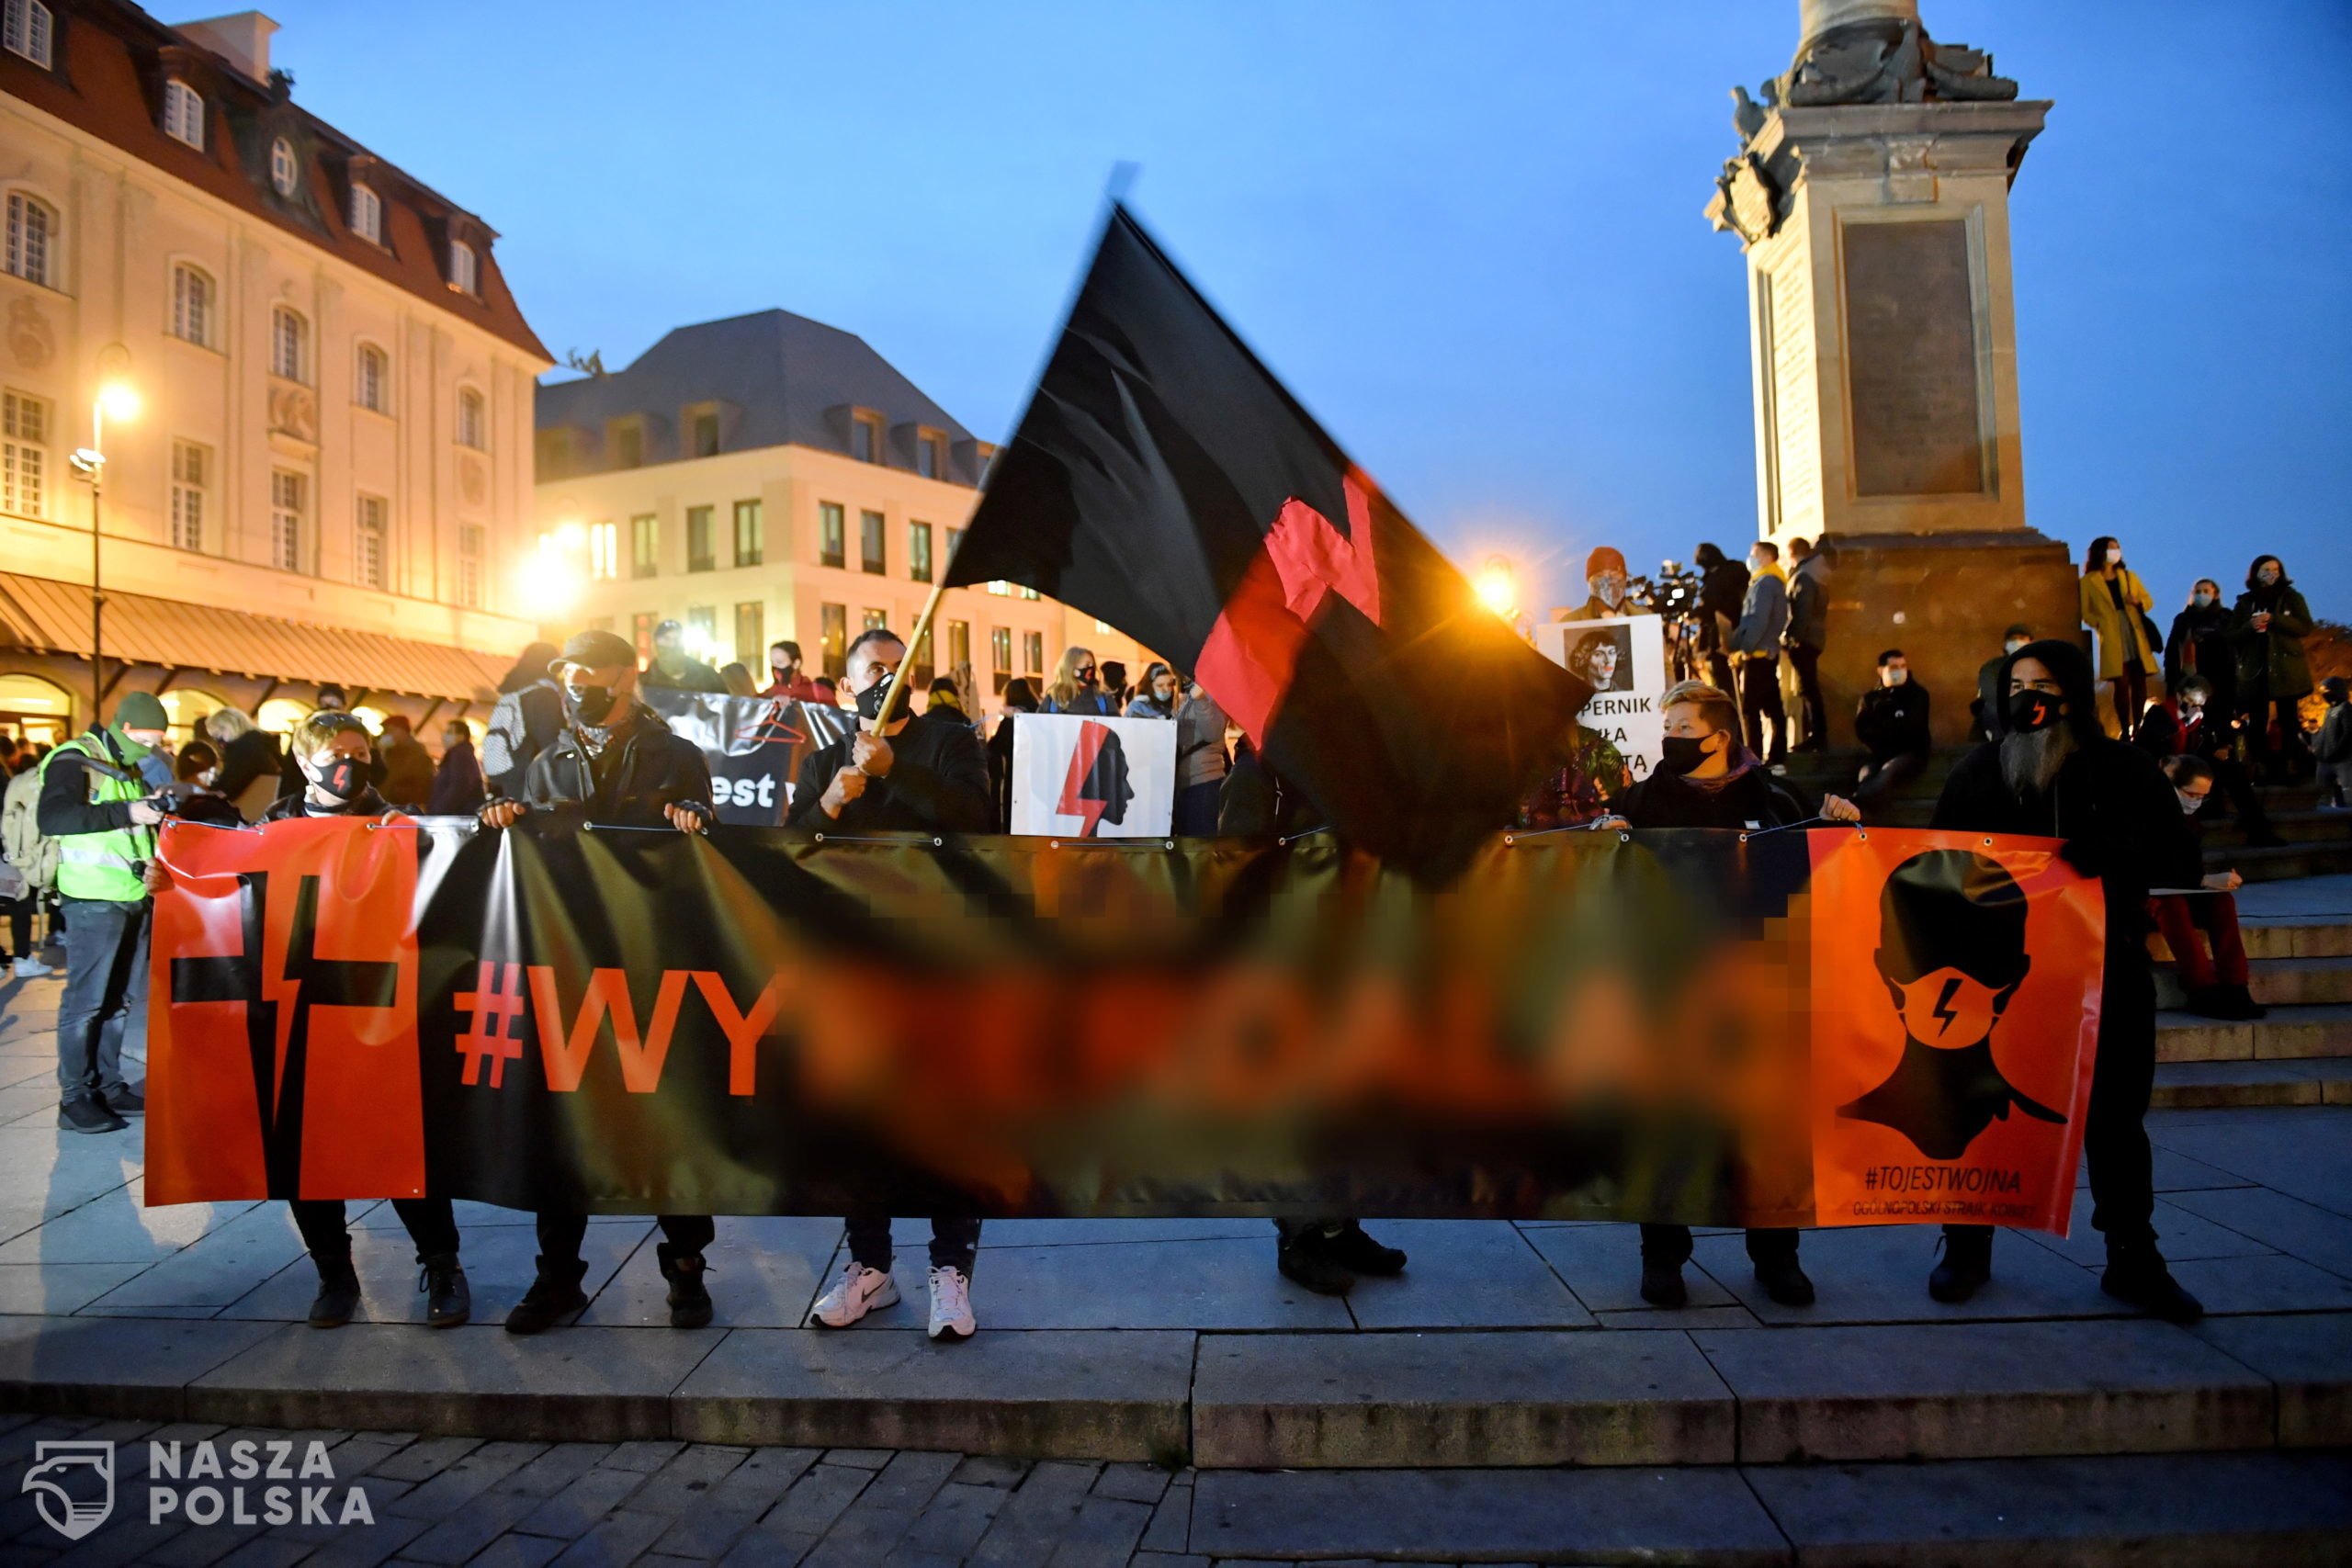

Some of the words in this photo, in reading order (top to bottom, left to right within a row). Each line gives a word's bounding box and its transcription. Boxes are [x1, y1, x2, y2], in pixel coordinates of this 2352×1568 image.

[1581, 697, 1651, 716] PERNIK
[1620, 754, 1647, 773] TĄ
[711, 773, 775, 808] est
[454, 961, 795, 1096] #WY
[1865, 1166, 2020, 1193] #TOJESTWOJNA
[1853, 1198, 1941, 1216] OGÓLNOPOLSKI
[1943, 1201, 1985, 1216] STRAJK
